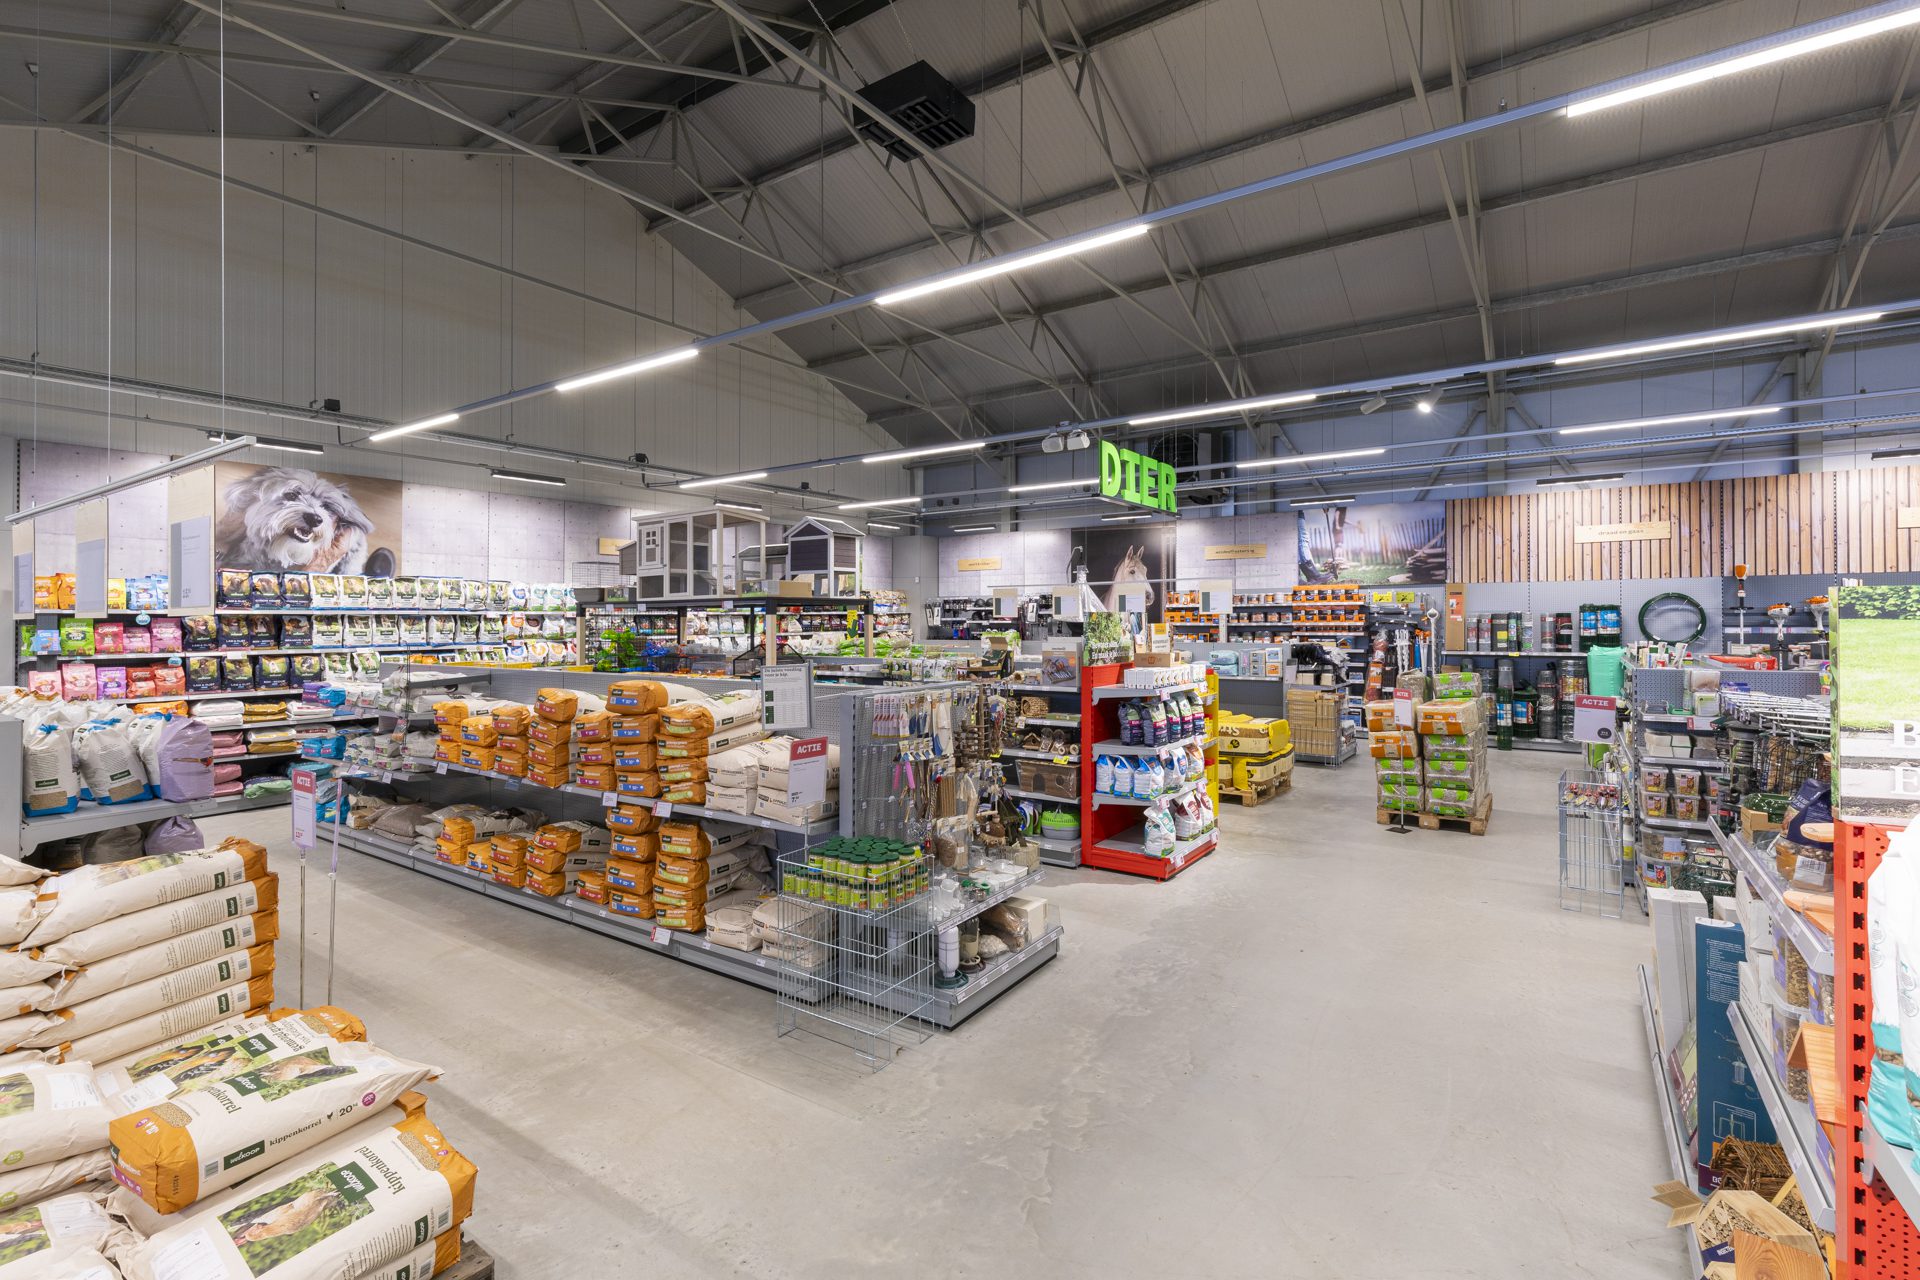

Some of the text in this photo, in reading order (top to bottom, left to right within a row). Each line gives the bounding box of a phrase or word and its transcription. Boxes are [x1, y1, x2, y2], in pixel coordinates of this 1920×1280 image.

[1101, 440, 1177, 513] DIER
[1582, 698, 1609, 706] ACTIE
[796, 743, 822, 754] ACTIE
[296, 776, 311, 787] ACTIE
[269, 1119, 322, 1146] kippenkorrel
[354, 1145, 406, 1196] kippenkorrel
